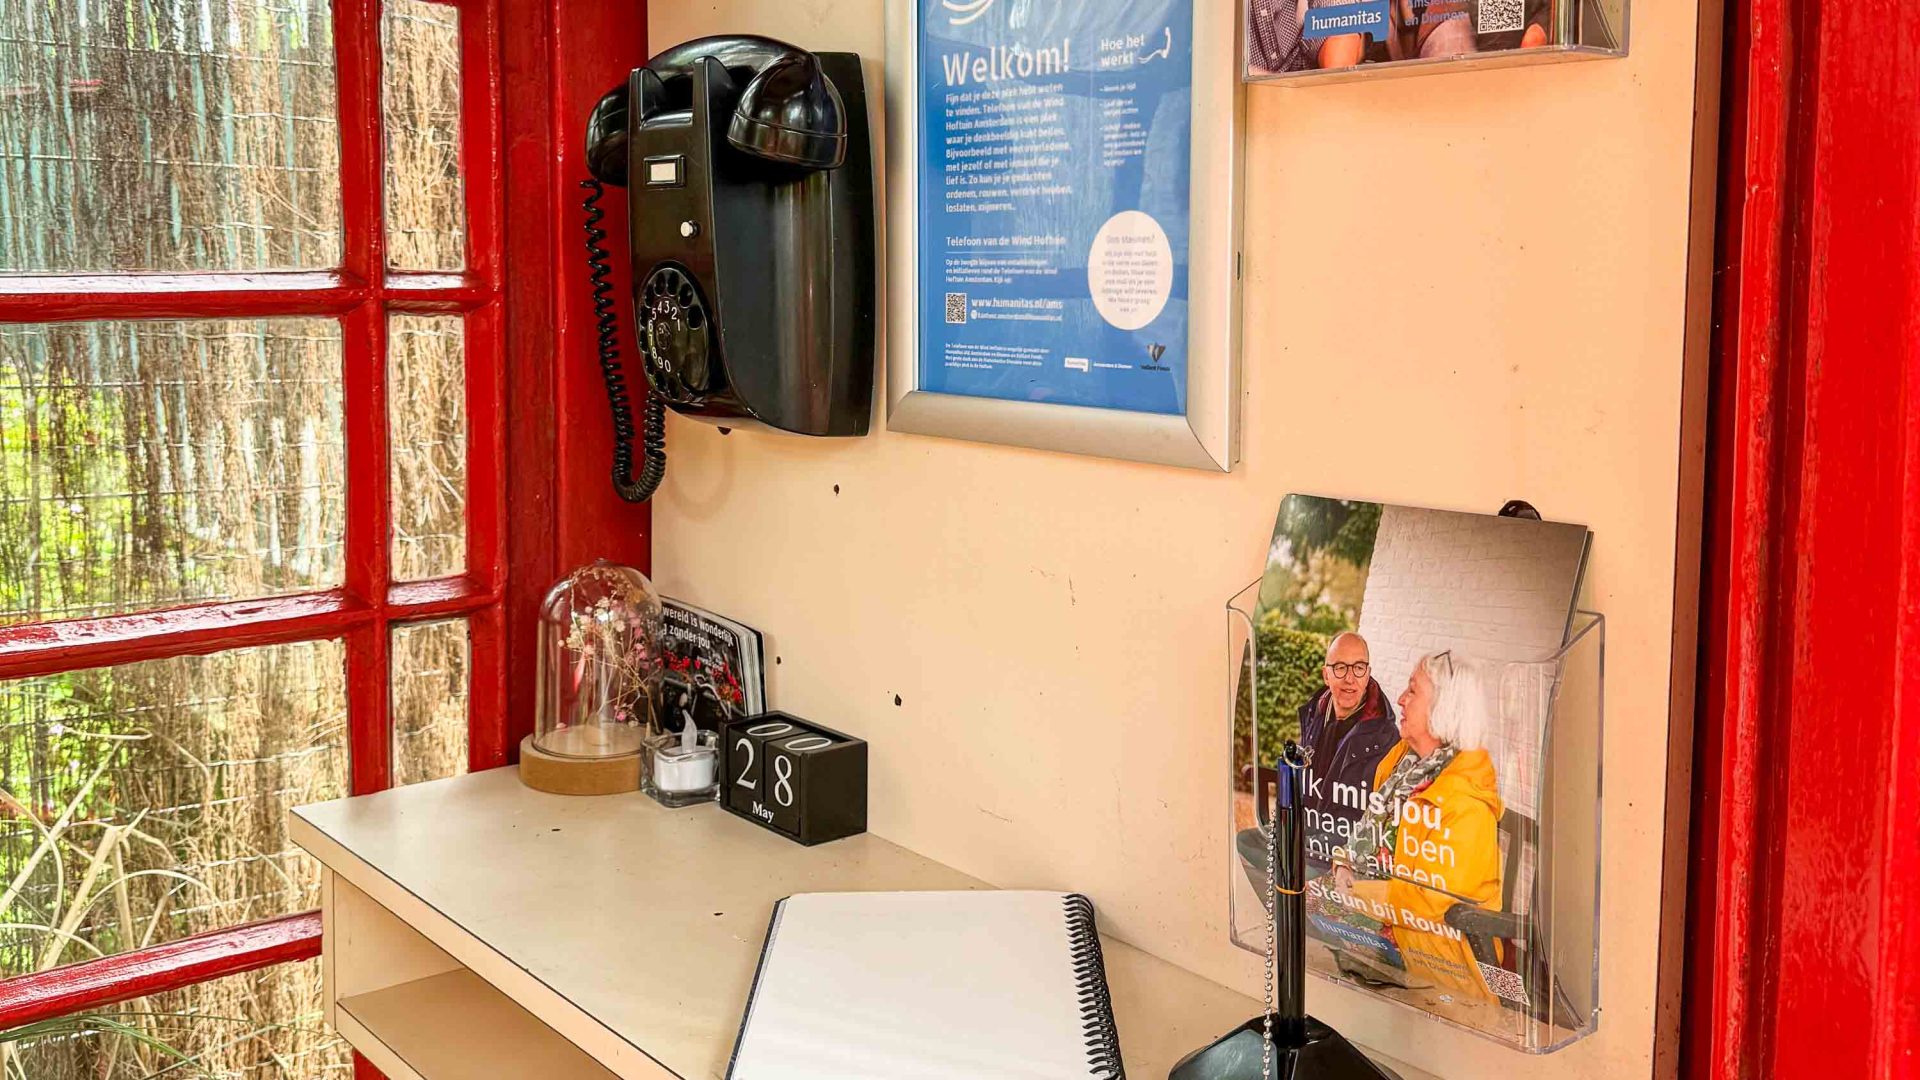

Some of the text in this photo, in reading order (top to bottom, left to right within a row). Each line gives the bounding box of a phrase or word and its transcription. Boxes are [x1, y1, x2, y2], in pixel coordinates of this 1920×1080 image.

[1311, 11, 1381, 30] humanitas
[1101, 34, 1145, 51] Hoe het
[942, 37, 1070, 87] Welkom!
[1101, 53, 1134, 67] werkt
[946, 94, 959, 105] Fijn
[960, 93, 972, 101] dat
[973, 93, 980, 103] je
[946, 107, 954, 117] te
[955, 106, 981, 116] vinden.
[1043, 97, 1065, 107] Wind
[946, 122, 972, 132] Hoftuin
[974, 116, 1016, 129] Amsterdam
[946, 136, 964, 145] waar
[965, 134, 972, 145] je
[946, 146, 992, 159] Bijvoorbeeld
[993, 146, 1007, 155] met
[946, 163, 960, 172] met
[961, 161, 983, 173] jezelf
[984, 160, 992, 169] of
[993, 160, 1008, 169] met
[946, 176, 958, 185] lief
[968, 175, 978, 184] Zo
[979, 175, 992, 184] kun
[993, 175, 1001, 185] je
[1002, 174, 1010, 184] je
[946, 190, 977, 200] ordenen,
[946, 236, 982, 246] Telefoon
[983, 238, 997, 246] van
[999, 236, 1010, 246] de
[1011, 235, 1032, 245] Wind
[657, 301, 662, 314] 4
[664, 300, 670, 314] 3
[671, 307, 678, 320] 2
[652, 308, 657, 321] 5
[648, 320, 653, 332] 6
[677, 319, 681, 332] 1
[648, 334, 653, 346] 7
[652, 347, 657, 359] 8
[657, 356, 663, 369] 9
[664, 359, 671, 372] 0
[662, 606, 734, 647] wereld is wonderlijk
[669, 624, 696, 644] zonder
[1302, 768, 1451, 840] Ik mis jou,
[752, 801, 774, 823] May
[1372, 817, 1393, 851] ik
[1403, 828, 1455, 868] ben
[1309, 835, 1447, 889] niet alleen
[1308, 880, 1462, 942] Steun bij Rouw
[1319, 919, 1389, 951] humanitas
